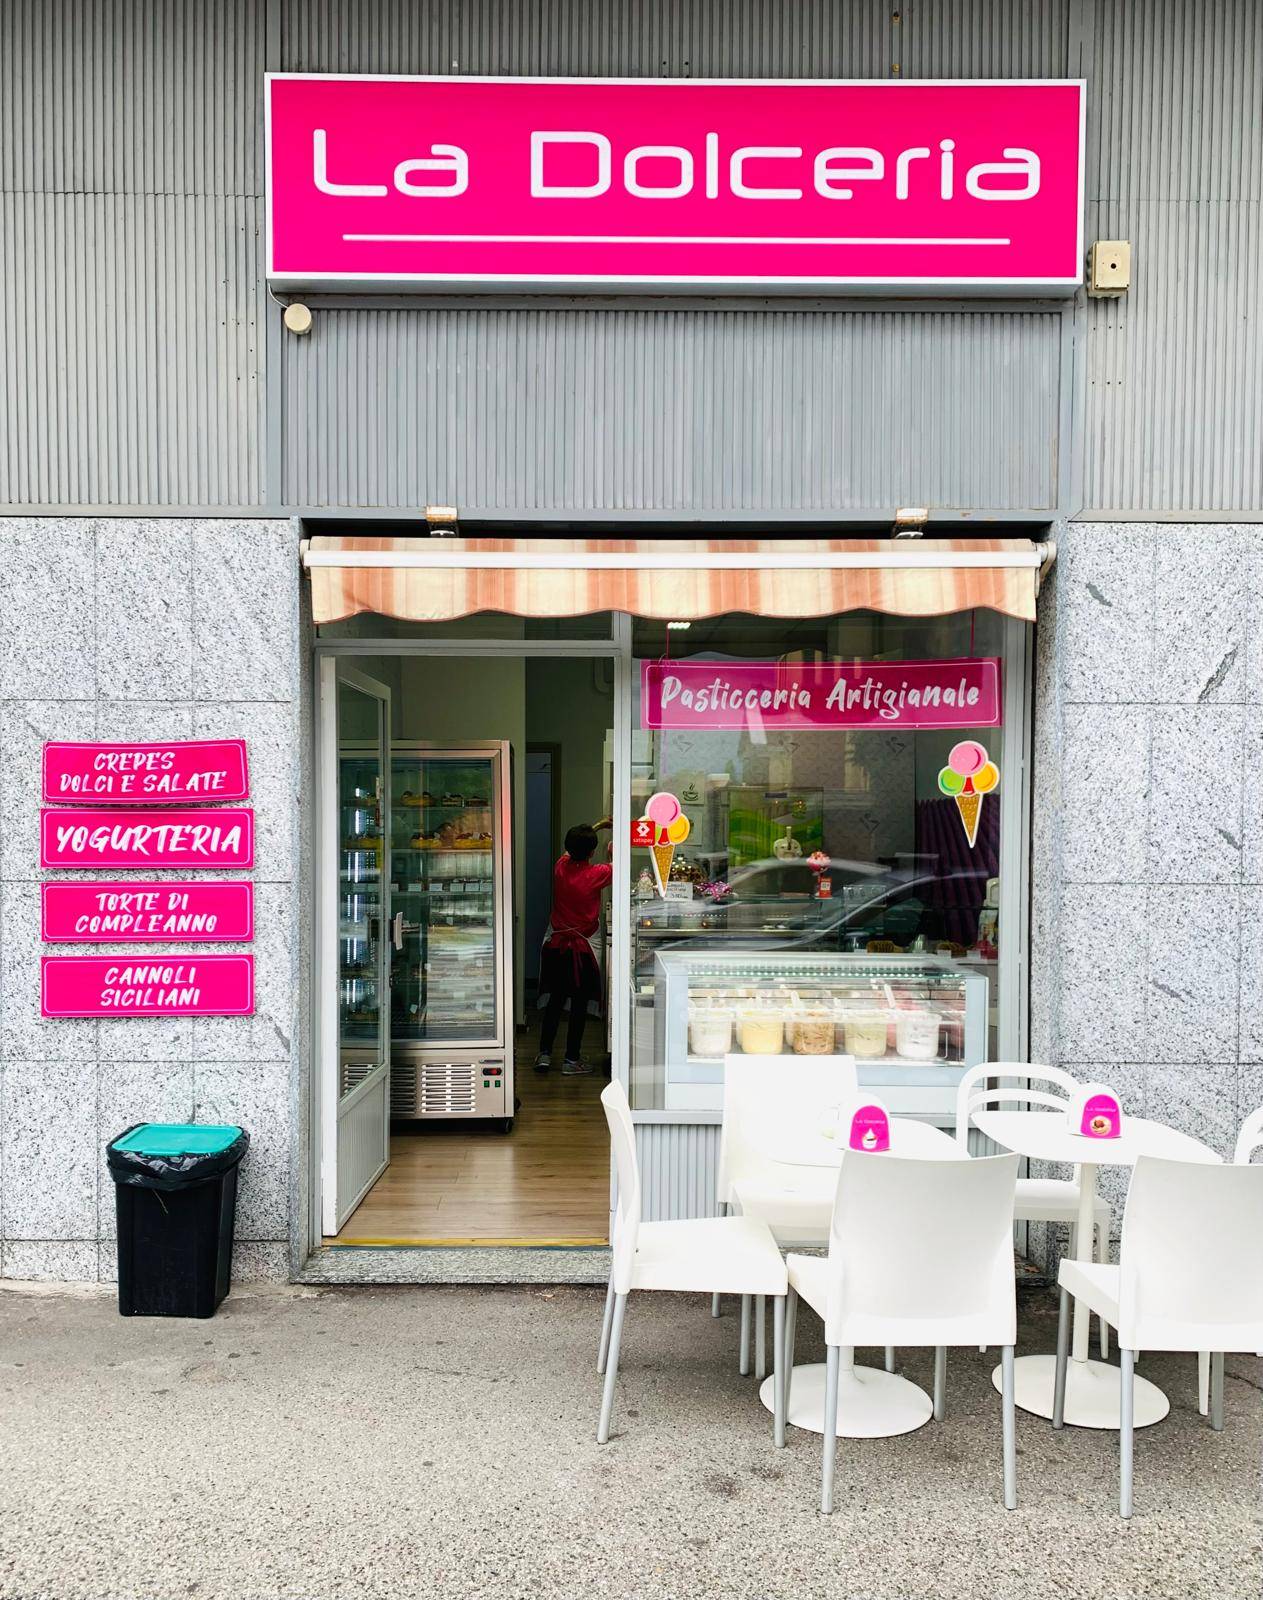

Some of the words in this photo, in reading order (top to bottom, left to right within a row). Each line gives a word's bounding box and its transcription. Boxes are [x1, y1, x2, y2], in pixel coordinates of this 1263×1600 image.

[313, 128, 469, 198] La
[530, 130, 1041, 201] Dolceria
[660, 676, 811, 713] Pasticceria
[826, 677, 980, 720] Artigianale
[93, 752, 176, 773] CREPES
[60, 774, 114, 793] DOLCI
[121, 774, 135, 793] E
[143, 770, 227, 793] SALATE
[56, 825, 242, 856] YOGURTERIA
[95, 892, 160, 913] TORTE
[168, 892, 189, 911] DI
[75, 913, 218, 933] COMPLEANNO
[104, 966, 196, 986] CANNOLI
[100, 987, 201, 1007] SICILIANI
